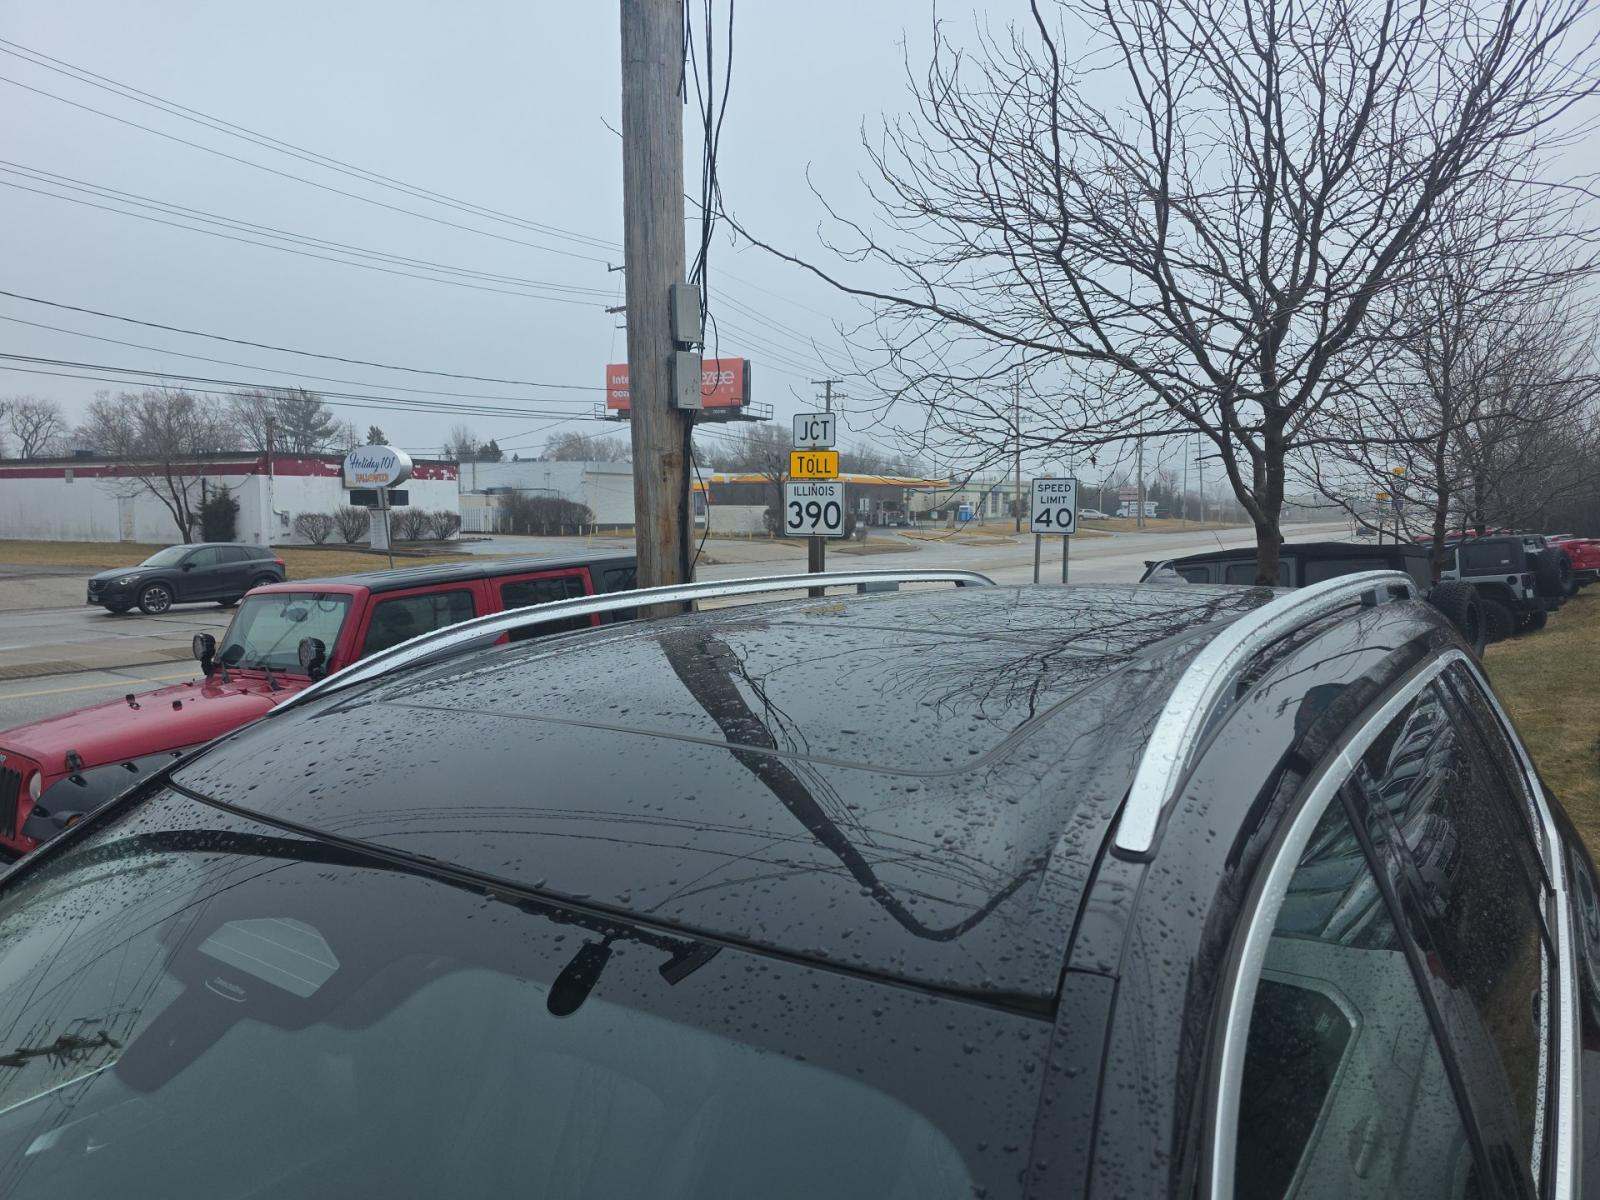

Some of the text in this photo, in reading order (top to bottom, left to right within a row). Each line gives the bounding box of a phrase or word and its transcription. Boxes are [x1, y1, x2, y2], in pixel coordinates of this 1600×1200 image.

[799, 420, 829, 441] JCT
[349, 453, 395, 472] Holiday 101
[797, 456, 831, 474] TOLL
[793, 486, 835, 496] ILLINOIS
[1037, 484, 1071, 492] SPEED
[1040, 496, 1067, 504] LIMIT
[788, 501, 841, 530] 390
[1034, 507, 1073, 528] 40
